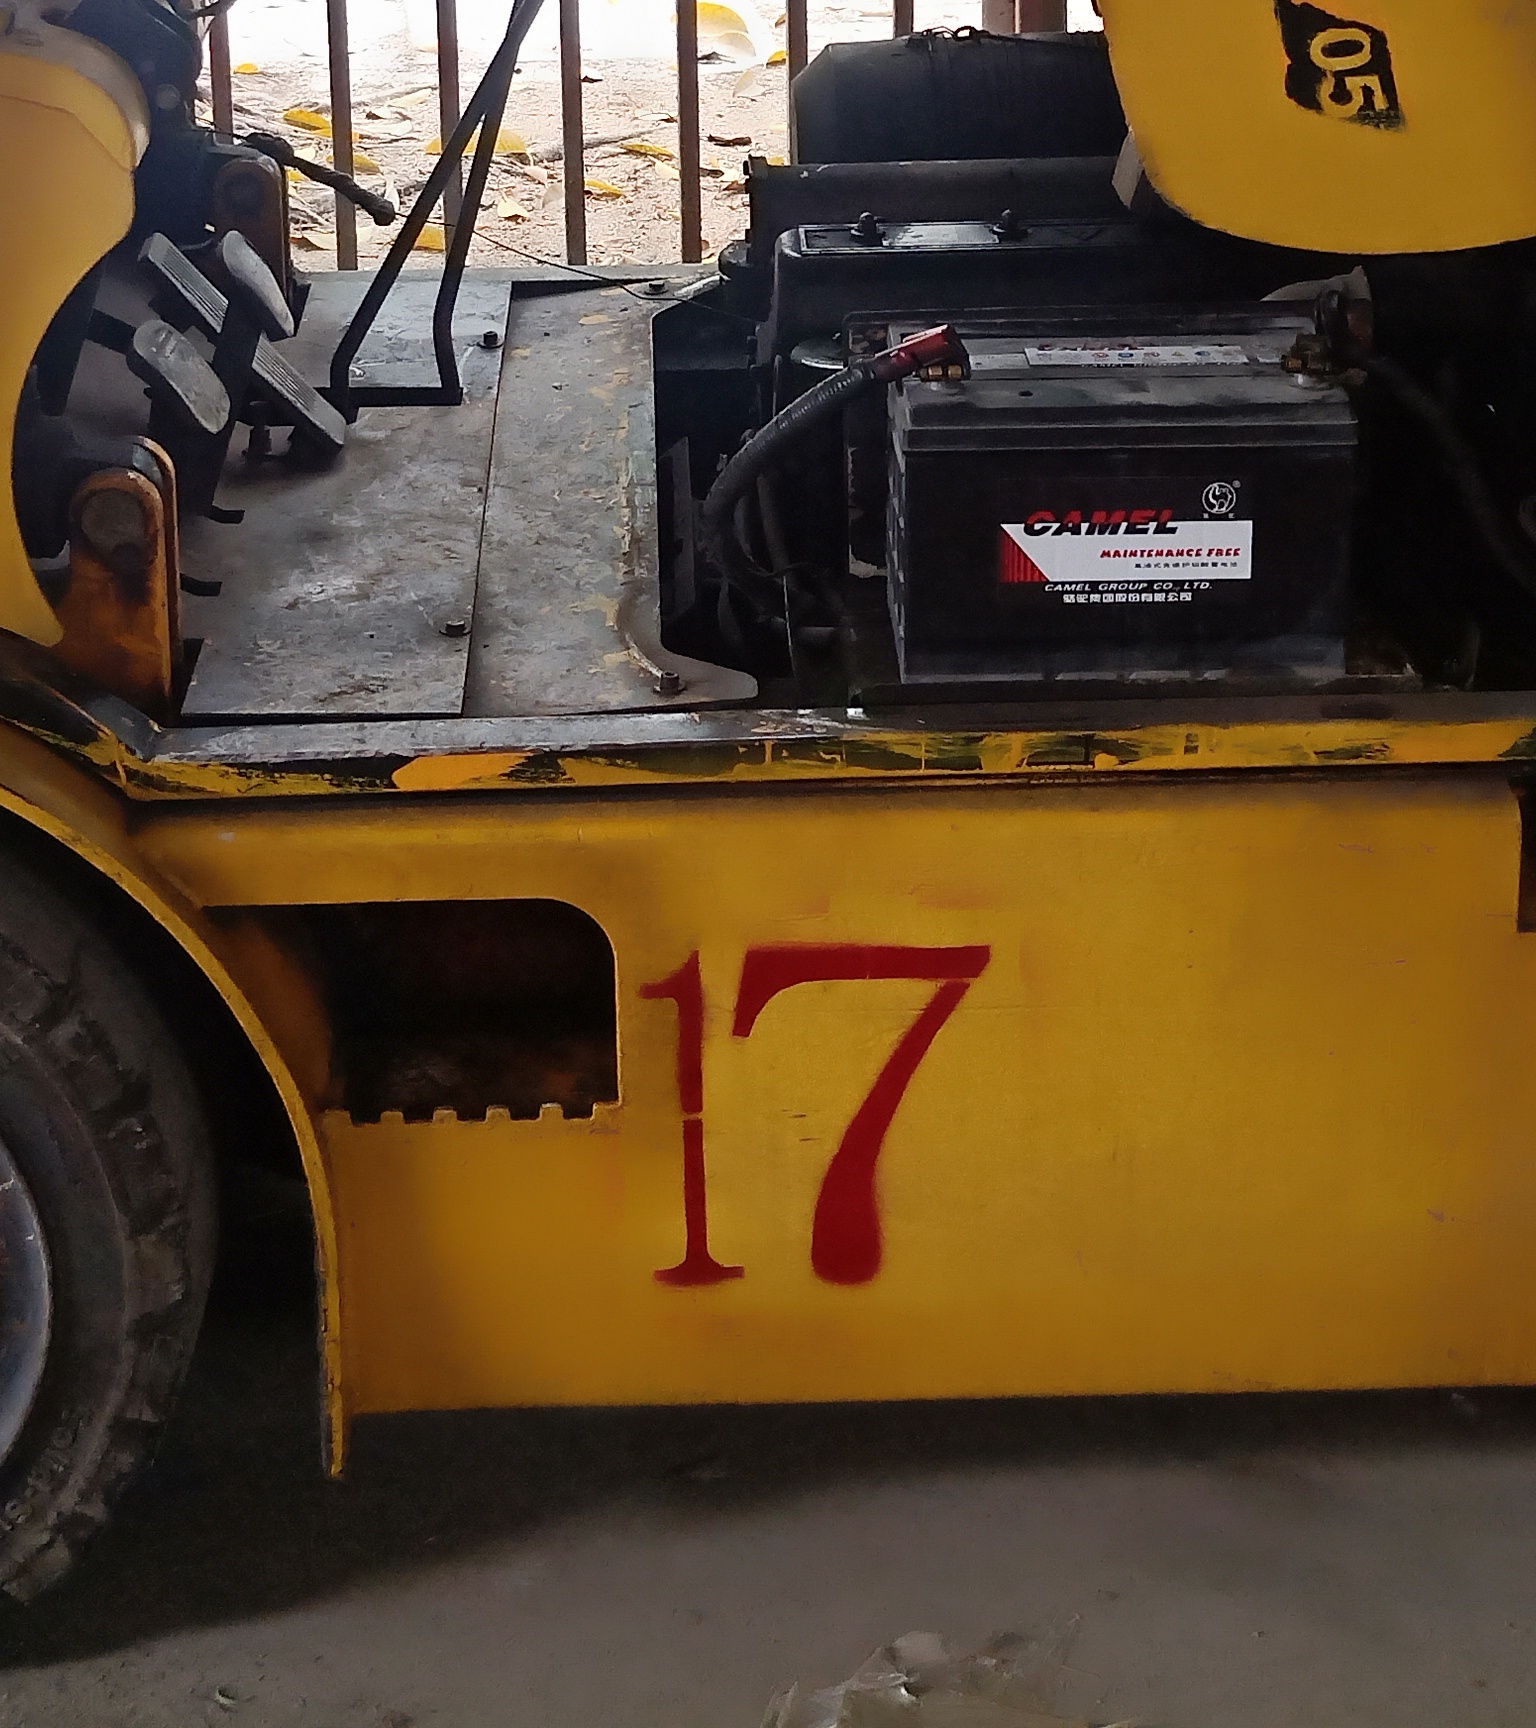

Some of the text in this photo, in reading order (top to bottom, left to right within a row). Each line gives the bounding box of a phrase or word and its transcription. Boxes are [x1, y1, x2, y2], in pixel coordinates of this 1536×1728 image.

[1022, 509, 1179, 537] CAMEL
[1100, 547, 1242, 559] MAINTENANCE FREE
[1044, 583, 1092, 592] CAMEL
[1098, 582, 1148, 592] GROUP
[1183, 581, 1213, 590] LTD.
[638, 941, 992, 1286] 17
